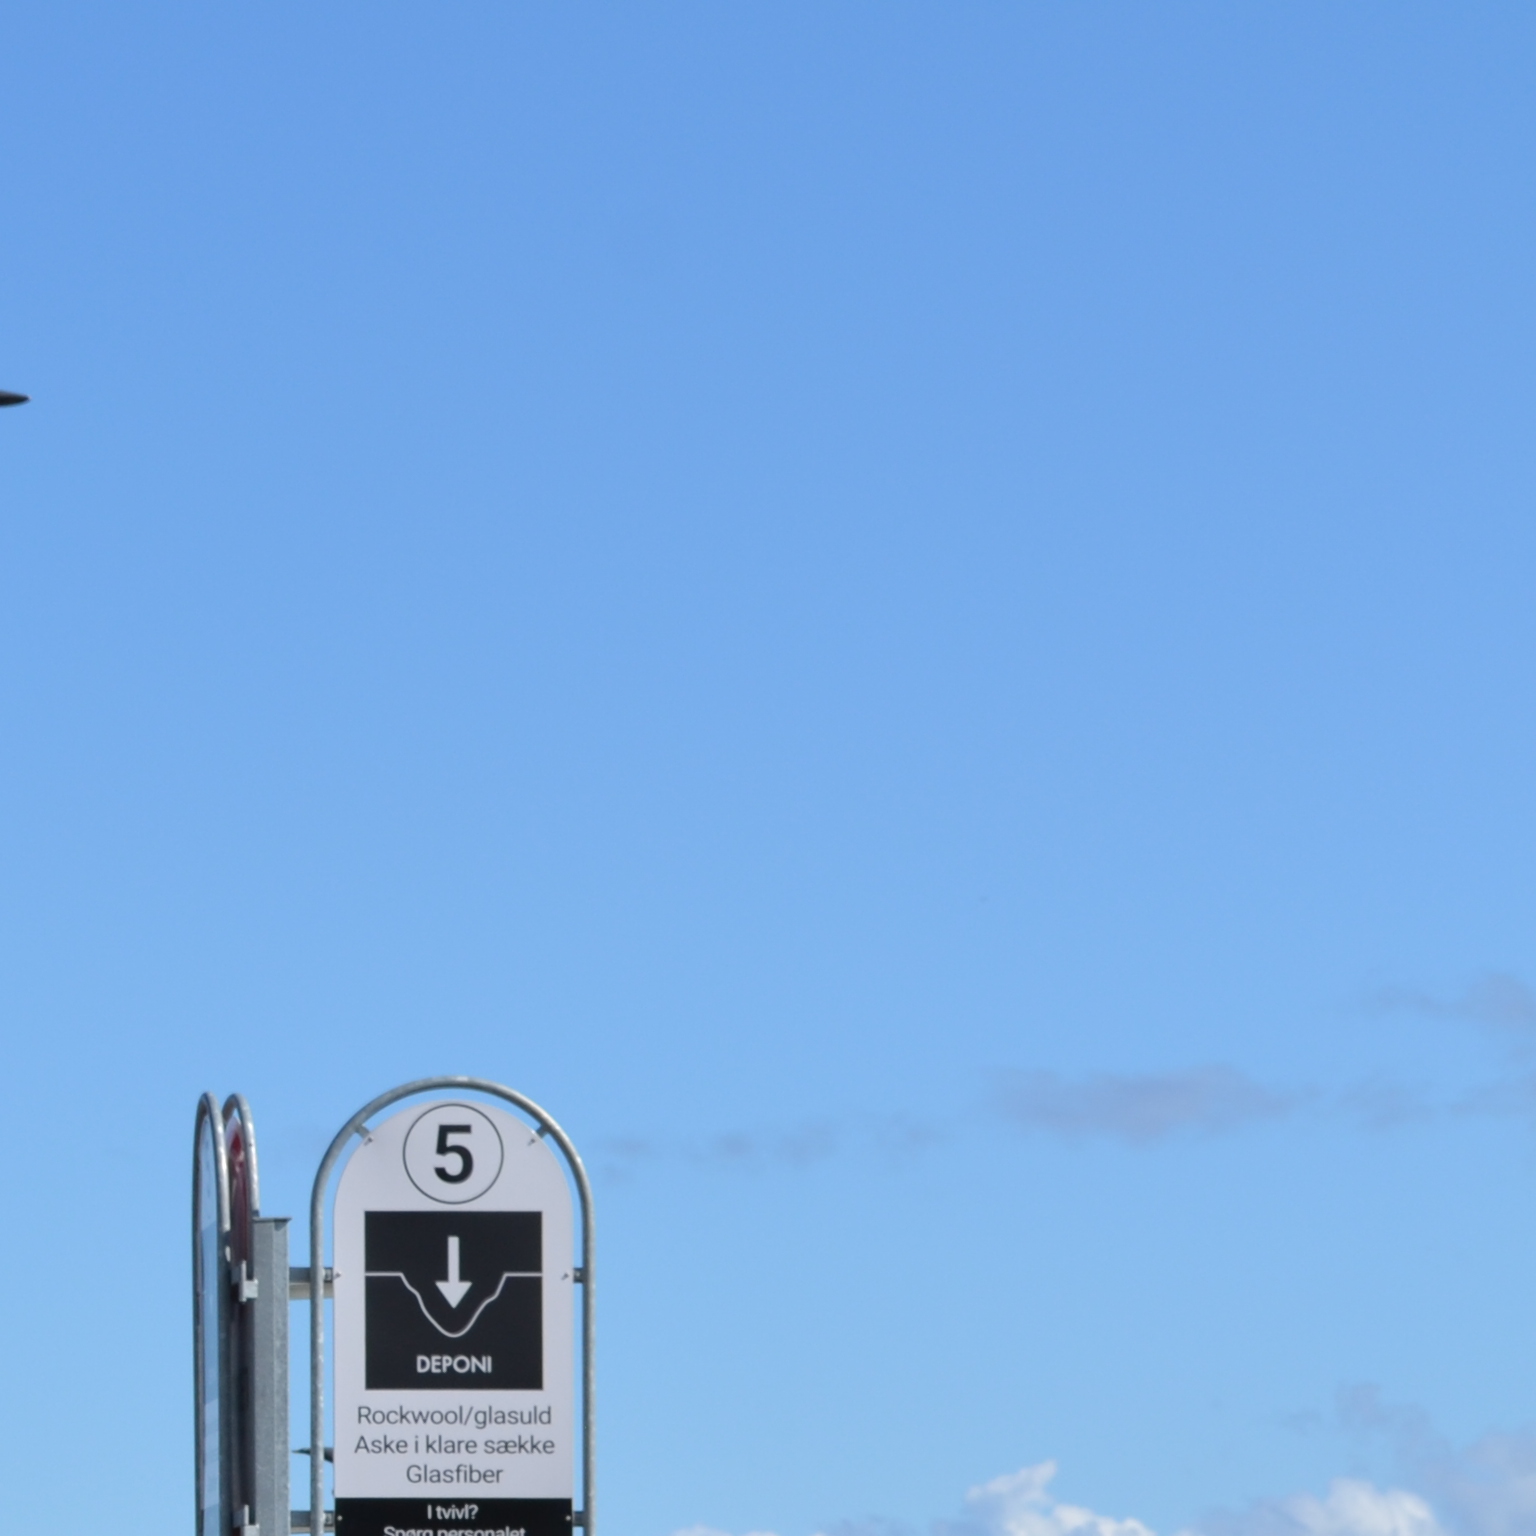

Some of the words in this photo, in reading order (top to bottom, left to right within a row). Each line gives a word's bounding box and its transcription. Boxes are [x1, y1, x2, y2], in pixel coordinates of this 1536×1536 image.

[433, 1124, 473, 1184] 5
[416, 1355, 492, 1373] DEPONI
[357, 1405, 551, 1430] Rockwool/glasuld
[354, 1435, 408, 1454] Aske
[414, 1435, 419, 1454] i
[426, 1434, 477, 1454] klare
[483, 1434, 555, 1454] sække
[406, 1463, 503, 1484] Glasfiber
[427, 1504, 432, 1519] I
[436, 1504, 478, 1520] tvivl?
